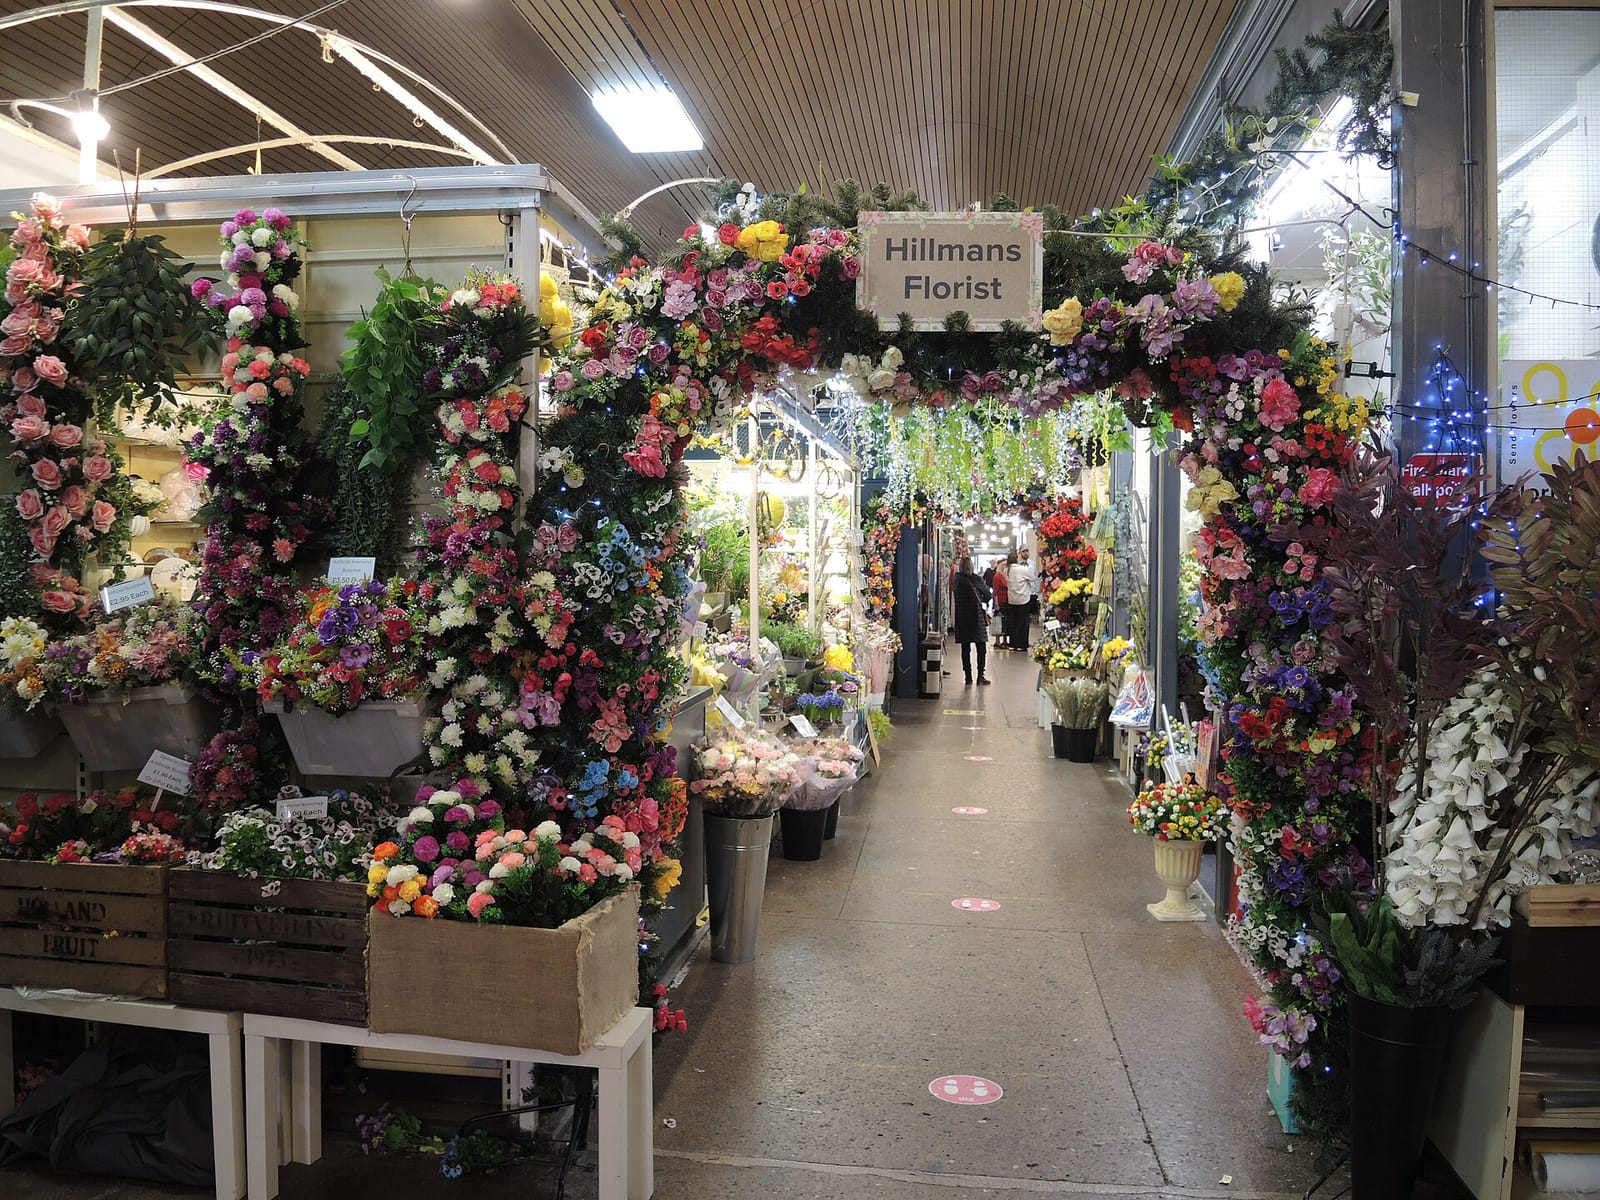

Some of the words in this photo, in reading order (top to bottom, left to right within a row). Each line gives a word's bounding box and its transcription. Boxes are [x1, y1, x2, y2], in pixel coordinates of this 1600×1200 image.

[886, 237, 1021, 262] Hillmans
[904, 275, 1002, 300] Florist
[1509, 436, 1517, 465] Send
[1407, 483, 1429, 497] all
[130, 588, 149, 599] Each
[43, 934, 99, 958] FRUIT
